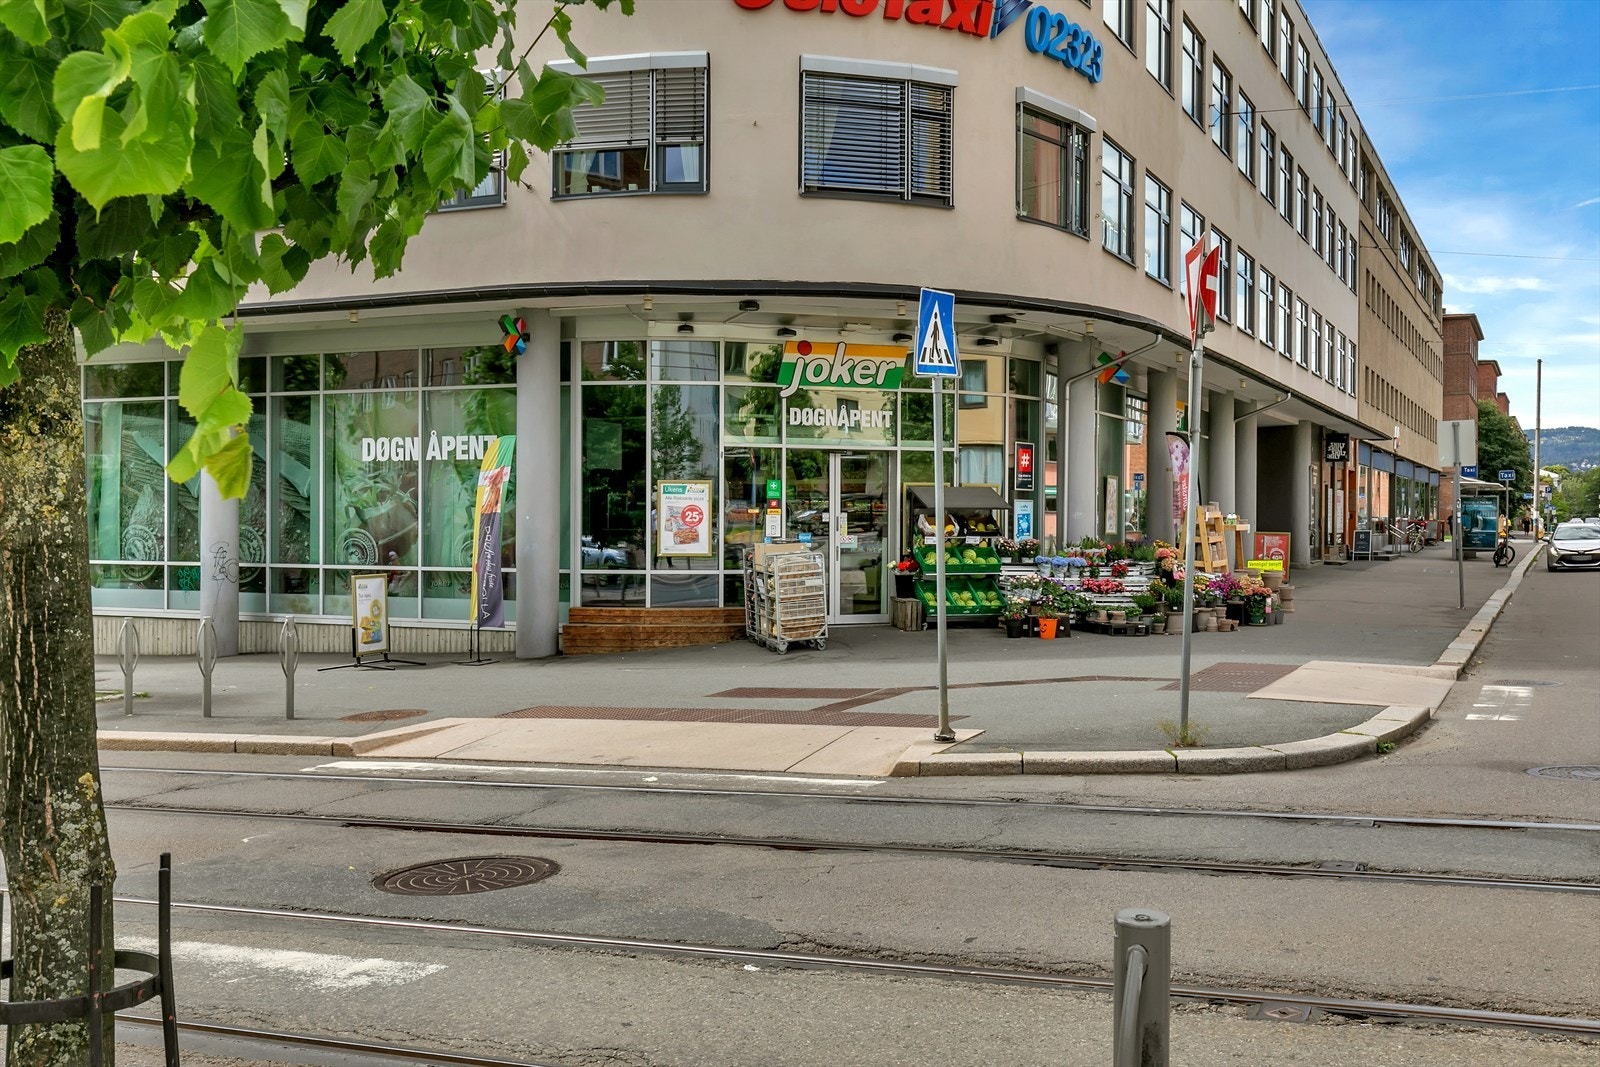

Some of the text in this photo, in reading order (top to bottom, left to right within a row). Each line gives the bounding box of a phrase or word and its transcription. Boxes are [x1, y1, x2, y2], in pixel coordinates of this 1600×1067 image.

[1025, 6, 1103, 83] 02323
[780, 340, 897, 398] joker
[789, 404, 893, 428] DØGNÅPENT
[362, 437, 419, 461] DØGN
[685, 511, 700, 522] 25
